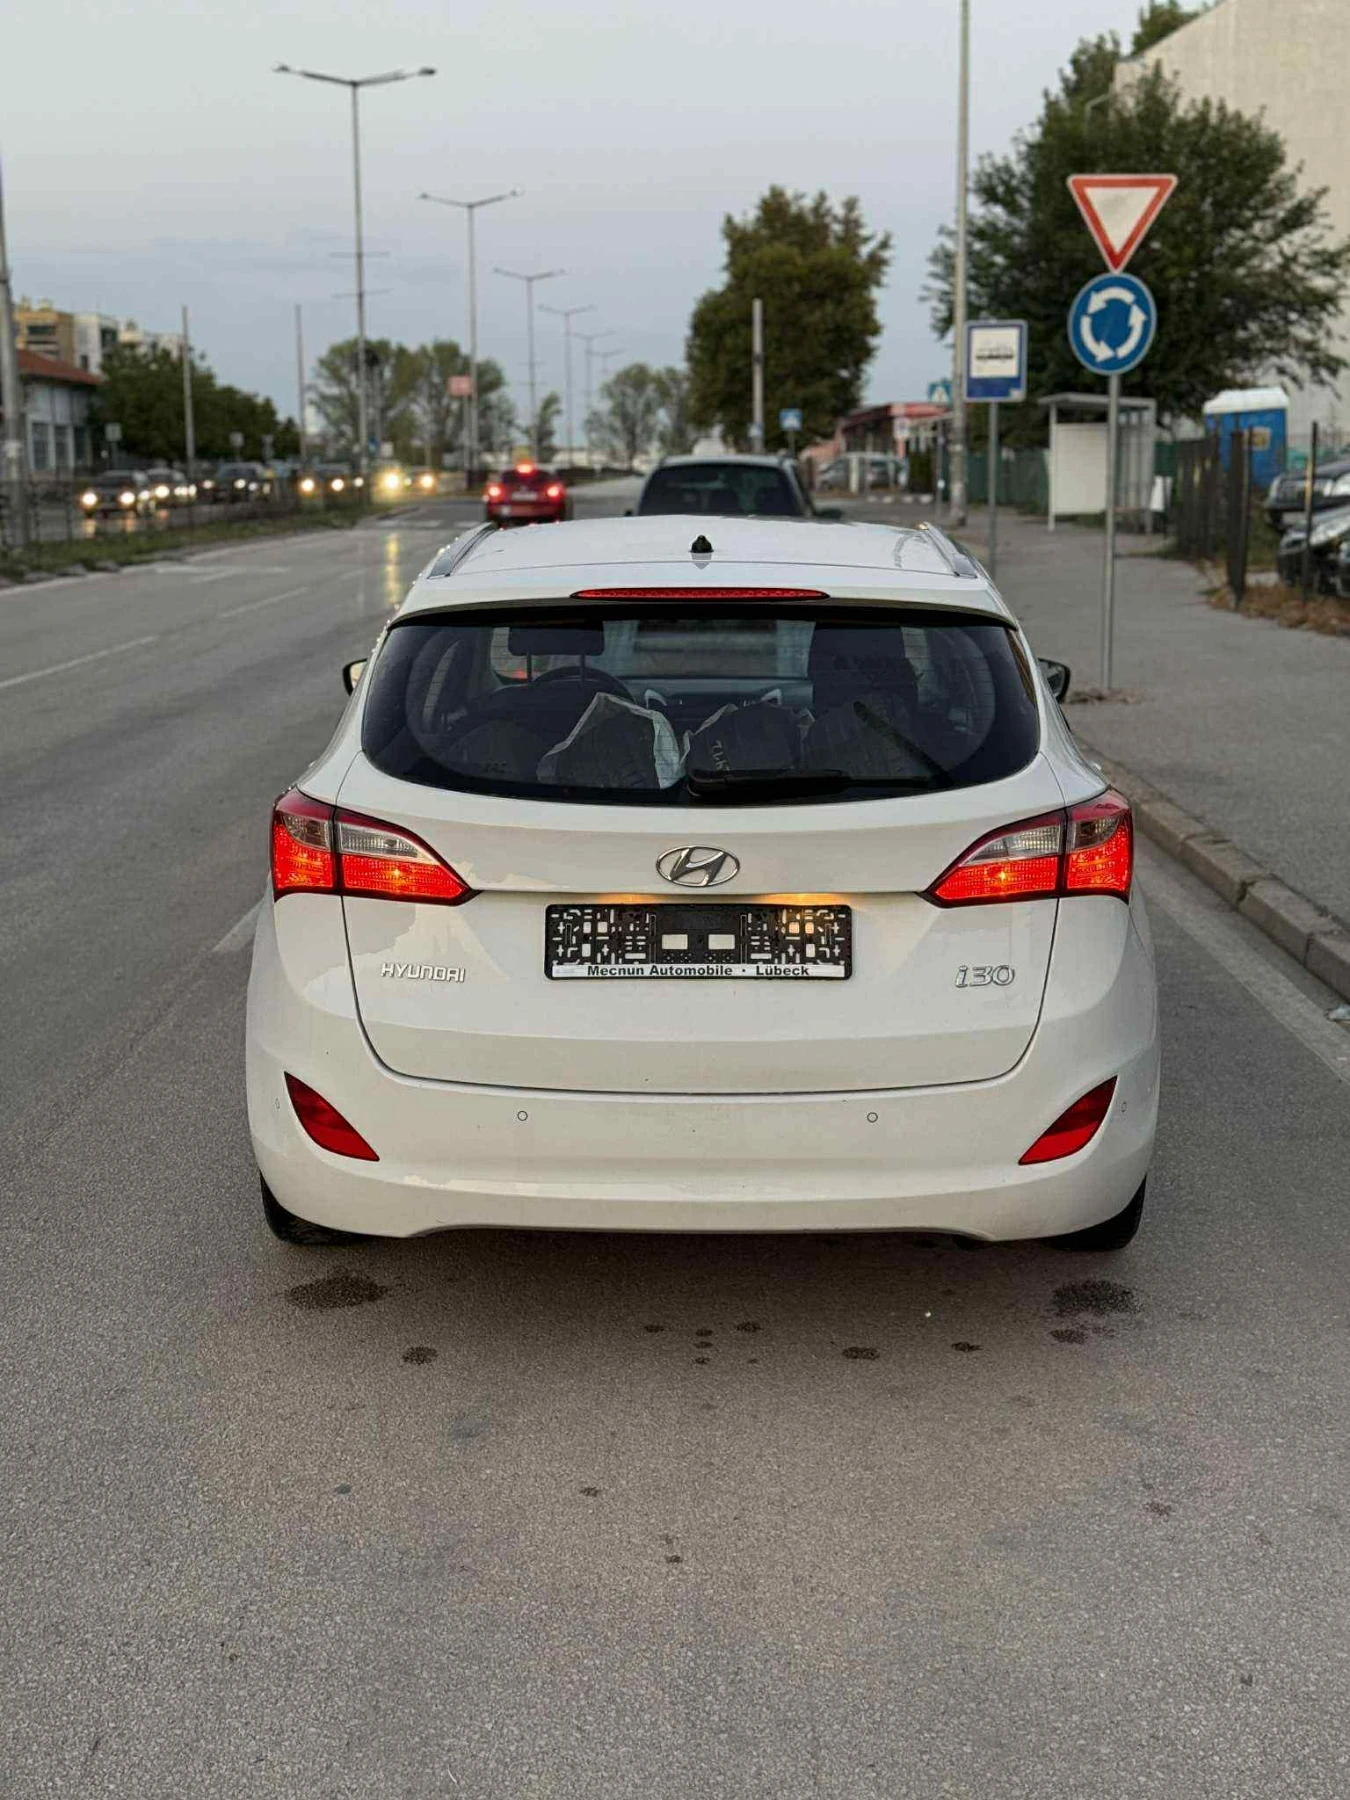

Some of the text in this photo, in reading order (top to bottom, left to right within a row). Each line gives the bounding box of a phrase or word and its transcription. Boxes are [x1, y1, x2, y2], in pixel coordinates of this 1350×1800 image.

[381, 962, 465, 982] HYUNDAI
[587, 964, 809, 976] Mecnun Automobile Lübeck
[955, 965, 1015, 988] i30
